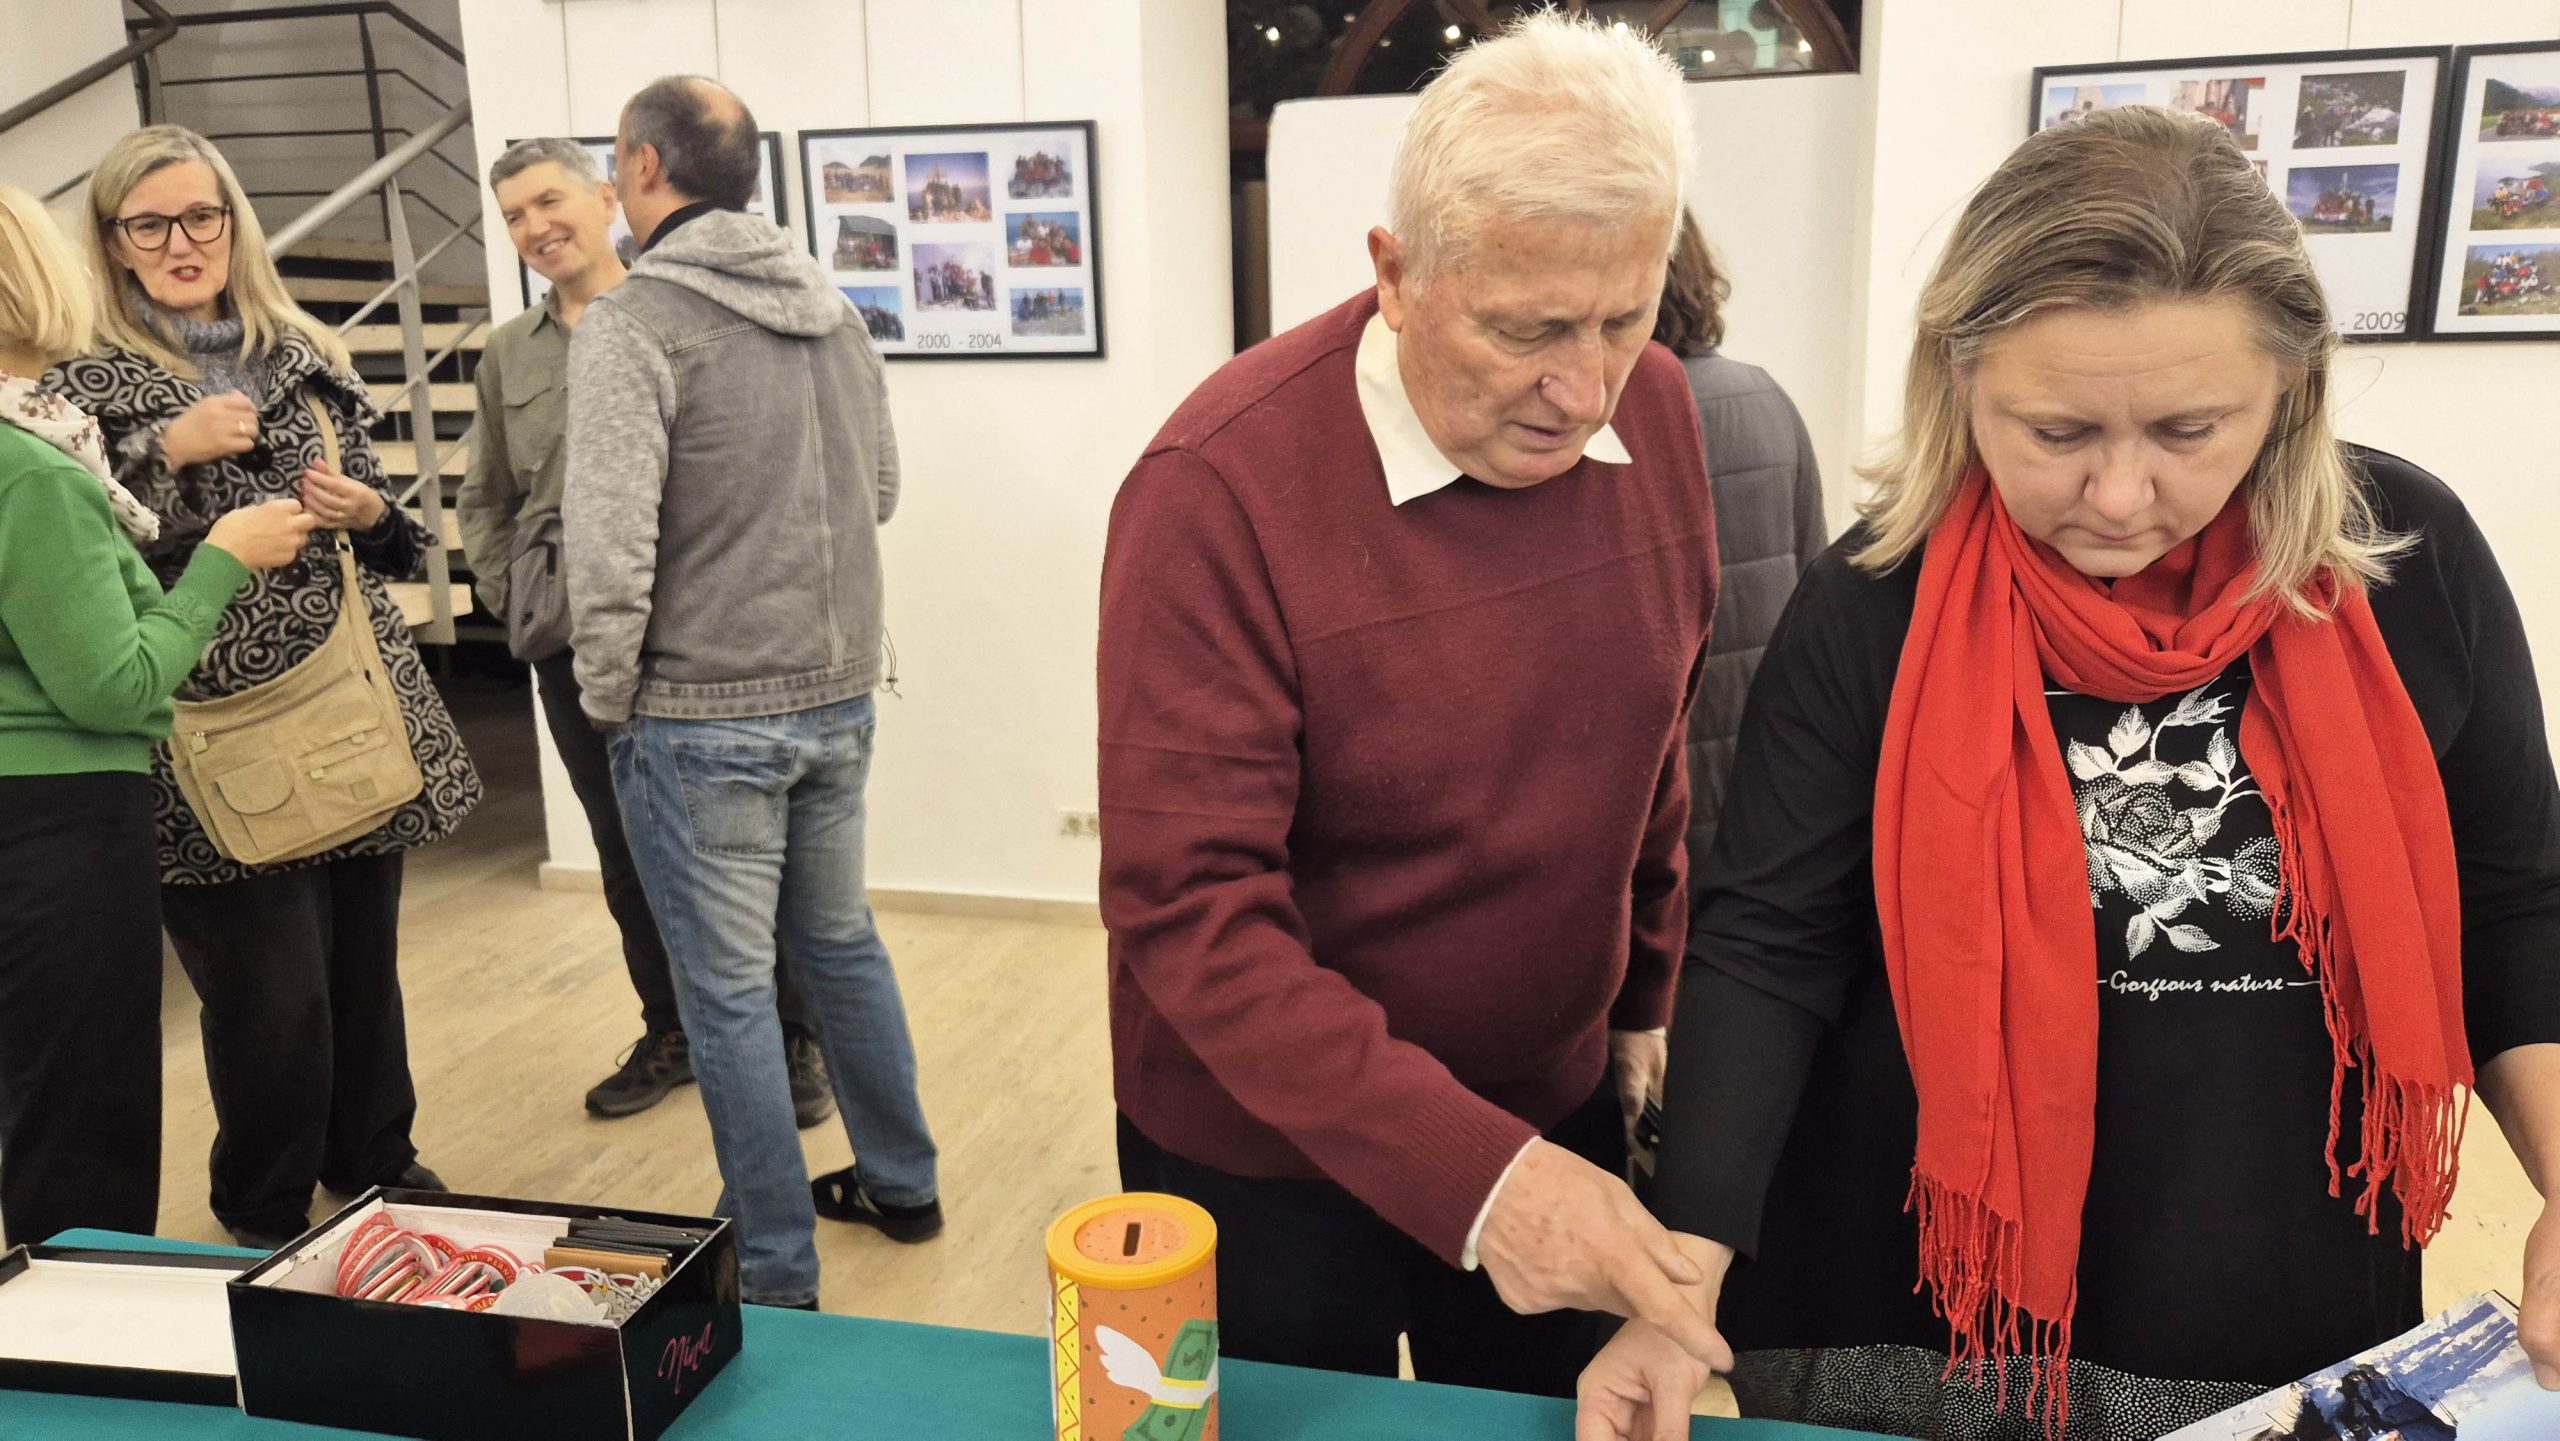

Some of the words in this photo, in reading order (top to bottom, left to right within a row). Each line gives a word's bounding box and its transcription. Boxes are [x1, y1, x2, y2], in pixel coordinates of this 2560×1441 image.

[2353, 312, 2407, 331] 2009
[917, 334, 951, 349] 2000
[968, 334, 1002, 349] 2004
[2110, 969, 2204, 1001] Gorgeous
[2210, 973, 2285, 993] nature
